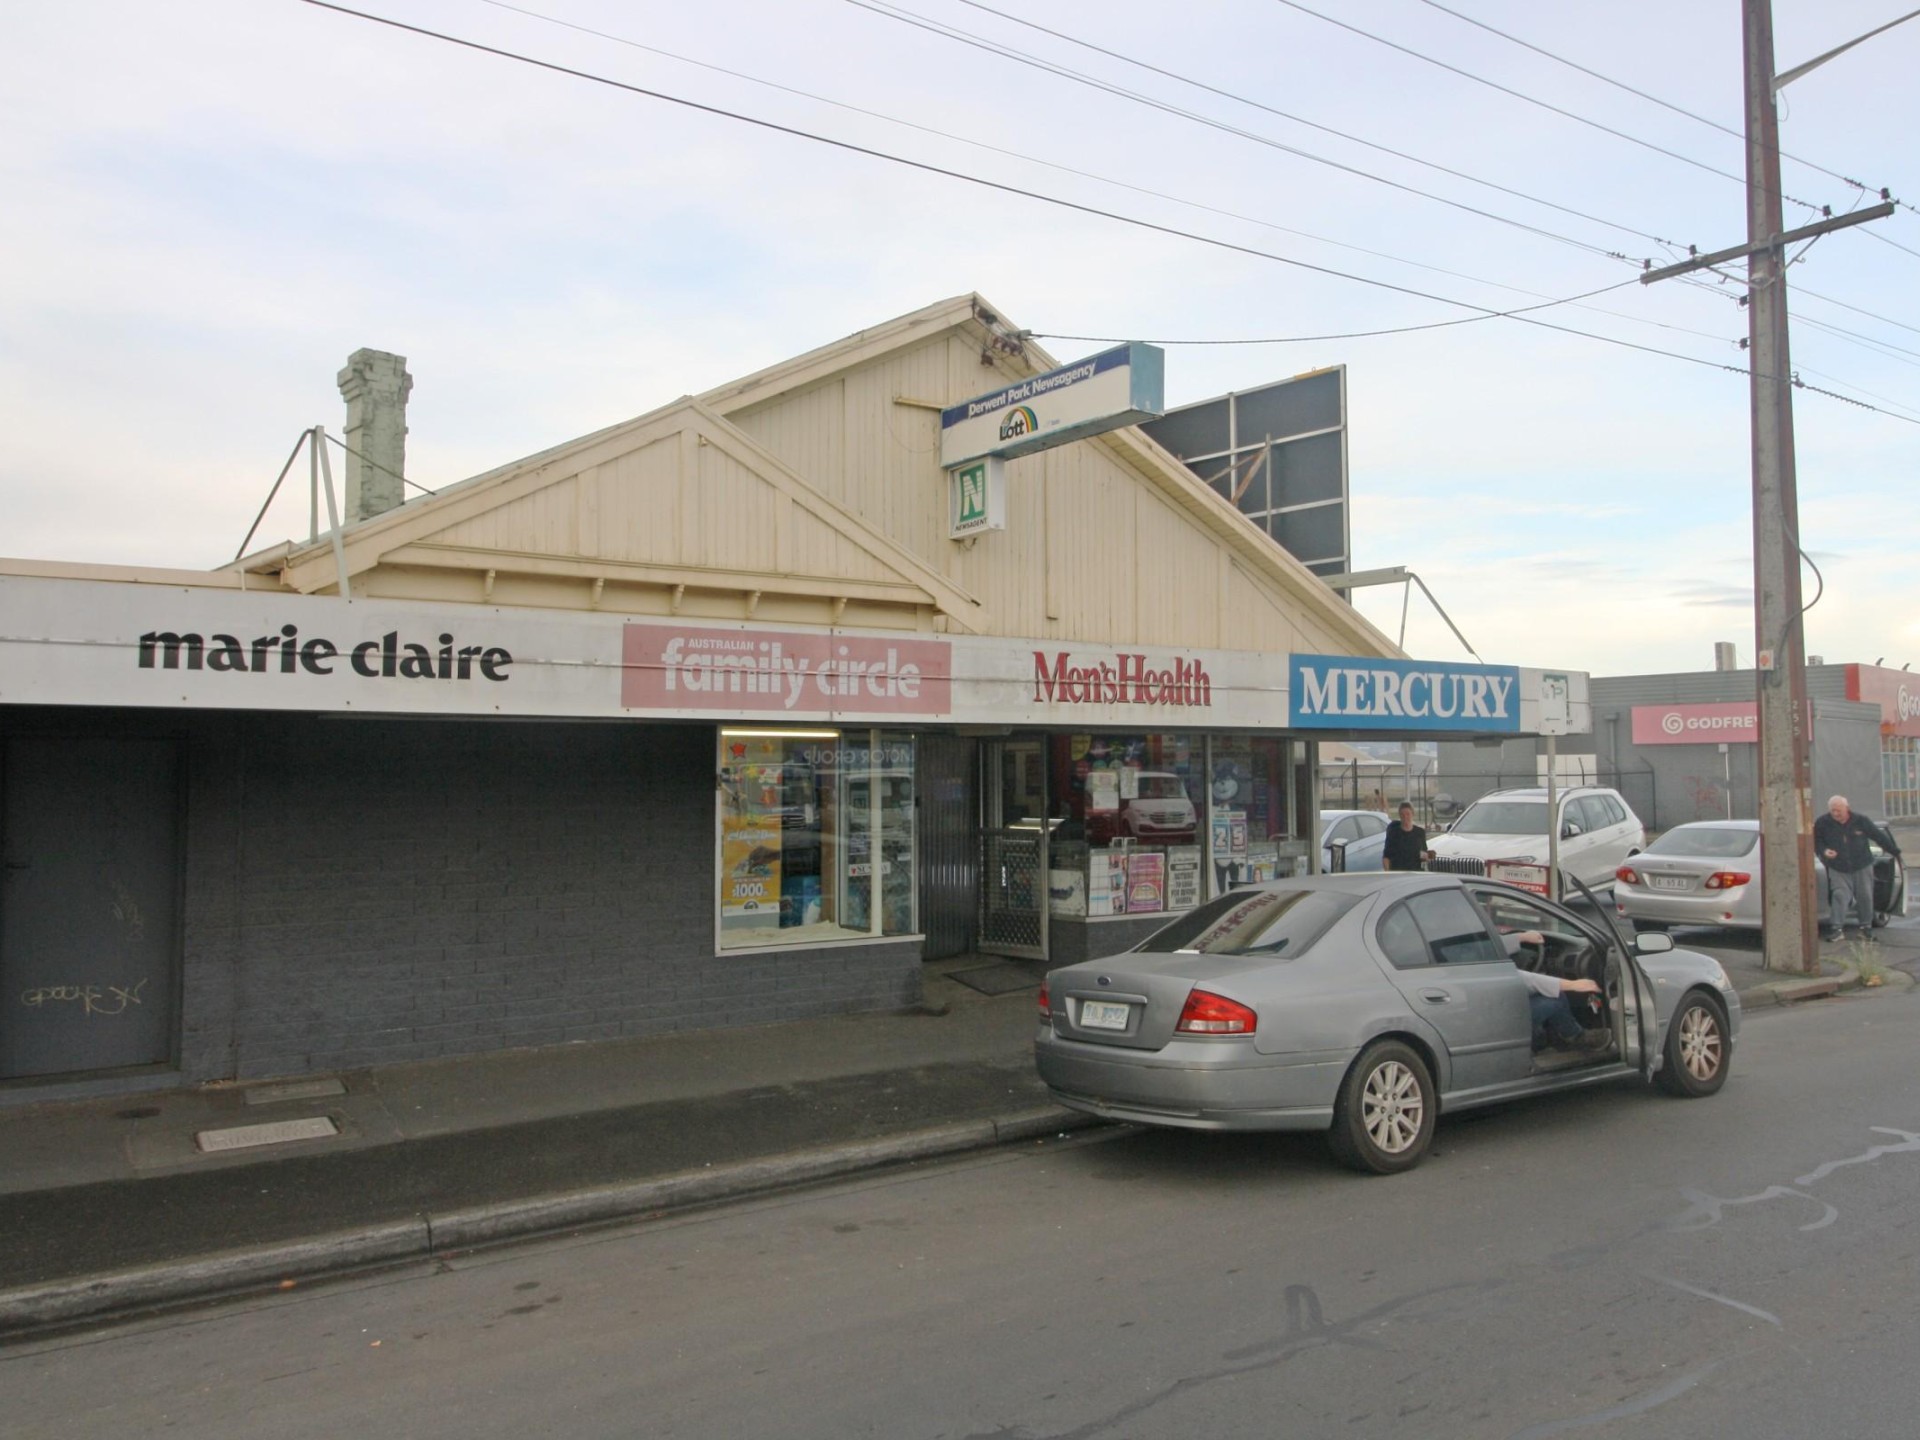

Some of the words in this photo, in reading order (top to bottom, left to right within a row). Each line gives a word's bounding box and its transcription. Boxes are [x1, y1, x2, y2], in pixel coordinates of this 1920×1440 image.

[969, 393, 1006, 418] Derwent
[1007, 384, 1031, 404] Park
[1032, 362, 1096, 394] Newsagency
[962, 470, 983, 517] N
[137, 623, 337, 675] marie
[350, 630, 514, 682] claire
[688, 638, 755, 651] AUSTRALIAN
[661, 637, 809, 709] family
[816, 646, 921, 699] circle
[1299, 666, 1513, 719] MERCURY
[1687, 715, 1758, 730] GODFRE
